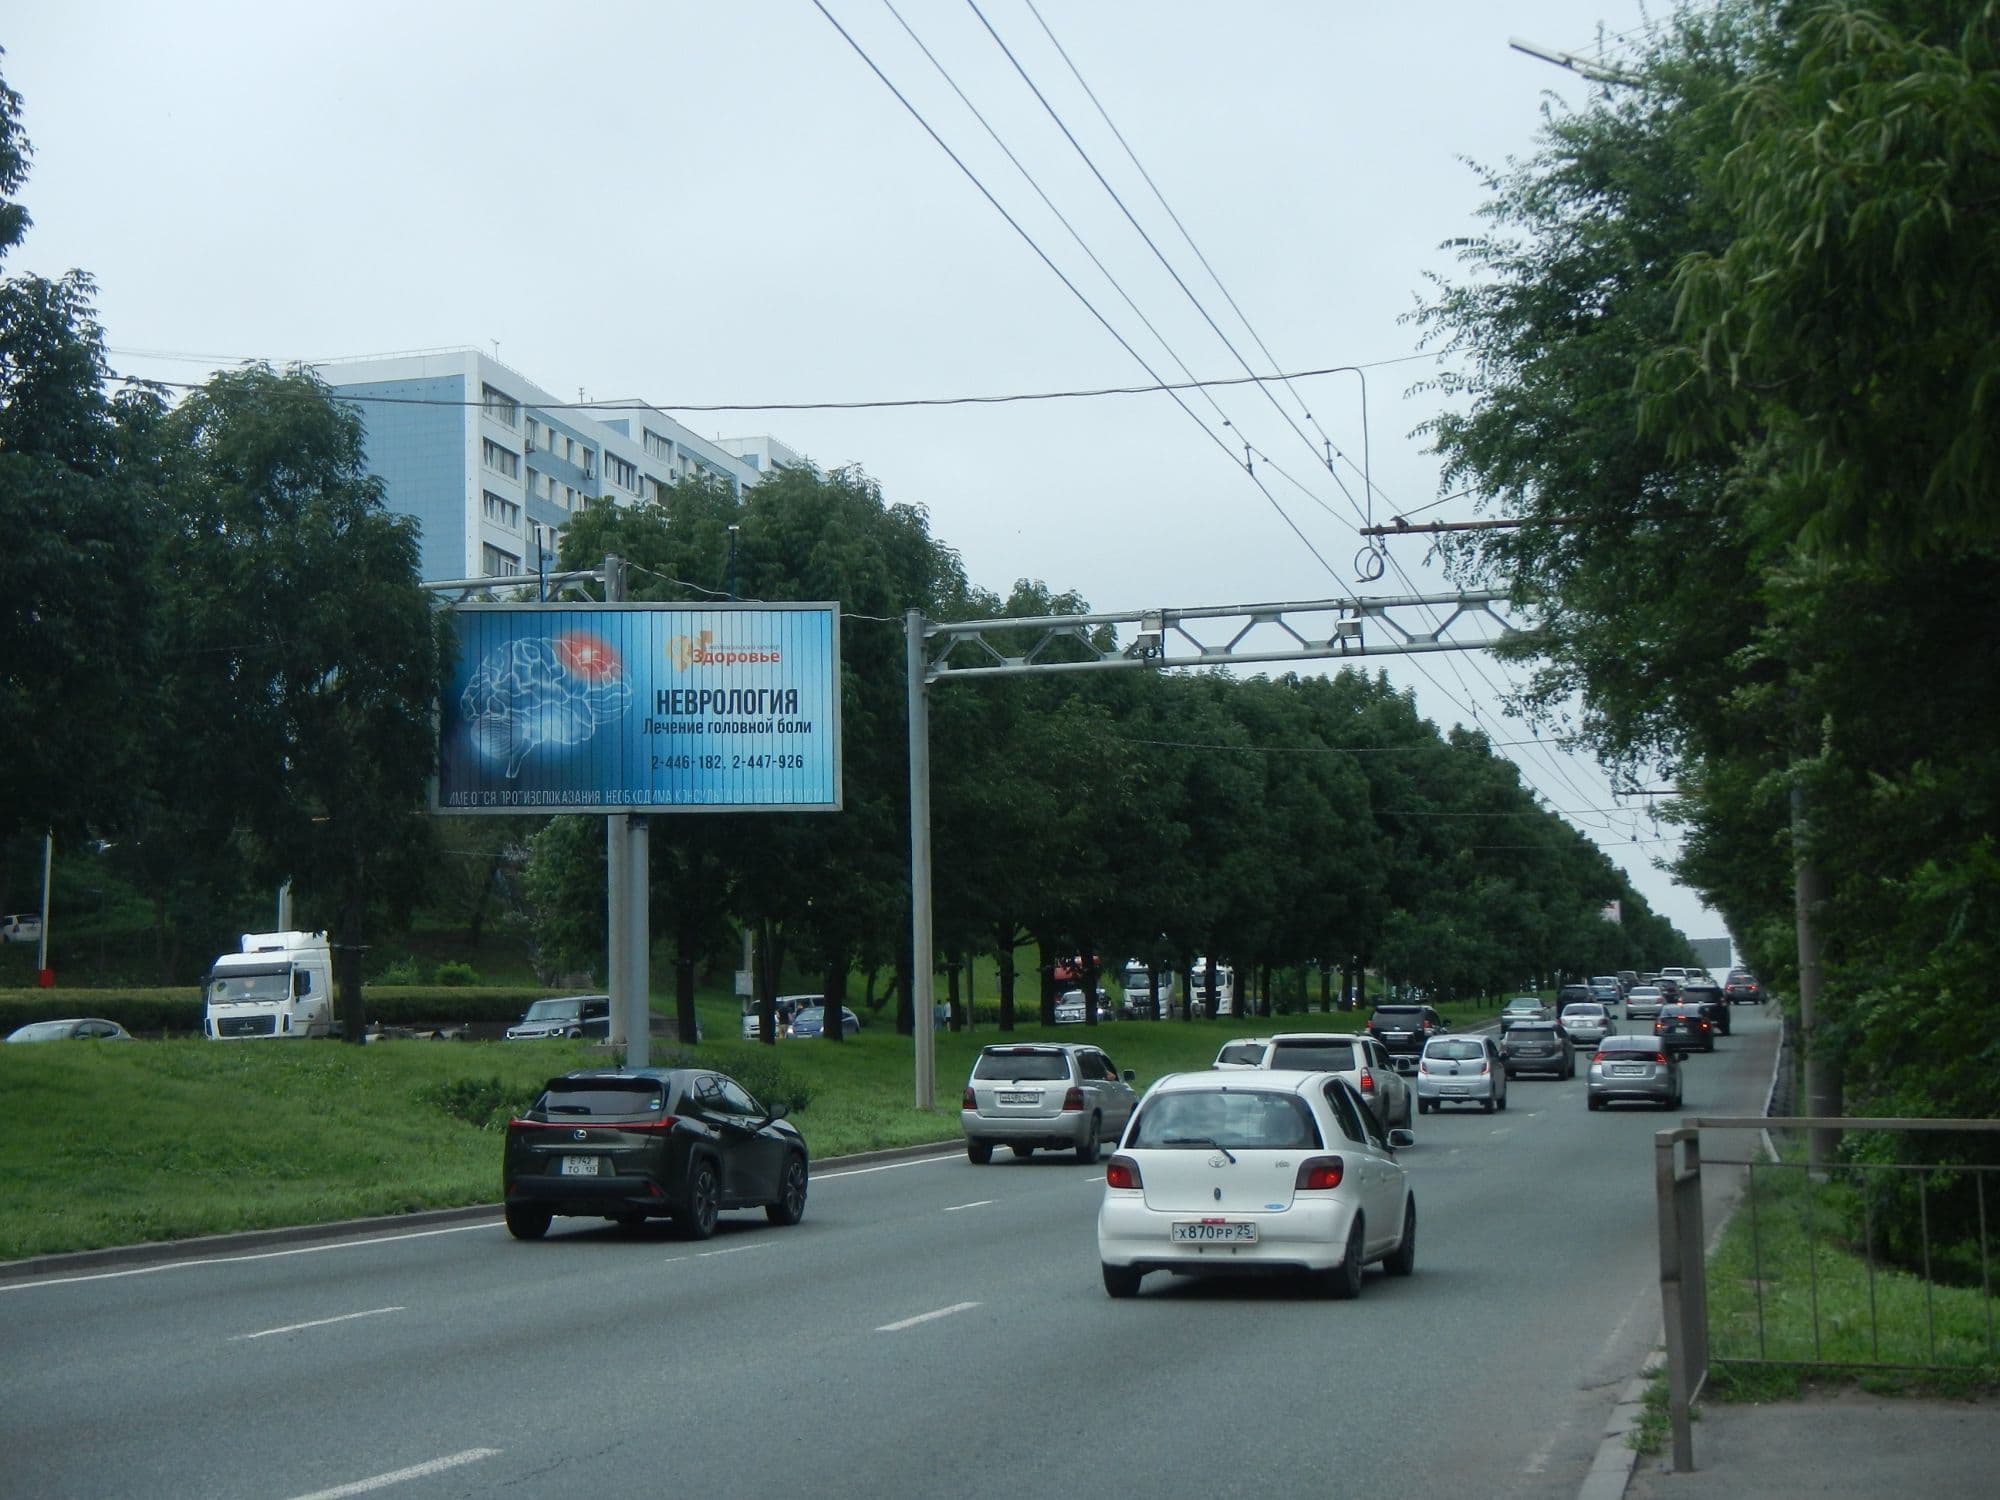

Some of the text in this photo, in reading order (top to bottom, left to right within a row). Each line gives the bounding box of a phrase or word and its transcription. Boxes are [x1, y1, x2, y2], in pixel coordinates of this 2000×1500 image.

[692, 648, 781, 667] Здоровье
[656, 688, 799, 716] НЕВРОЛОГИЯ
[643, 718, 812, 734] Лечение головной боли
[651, 754, 804, 771] 2-446-182, 2-447-926
[1237, 1224, 1251, 1236] 25
